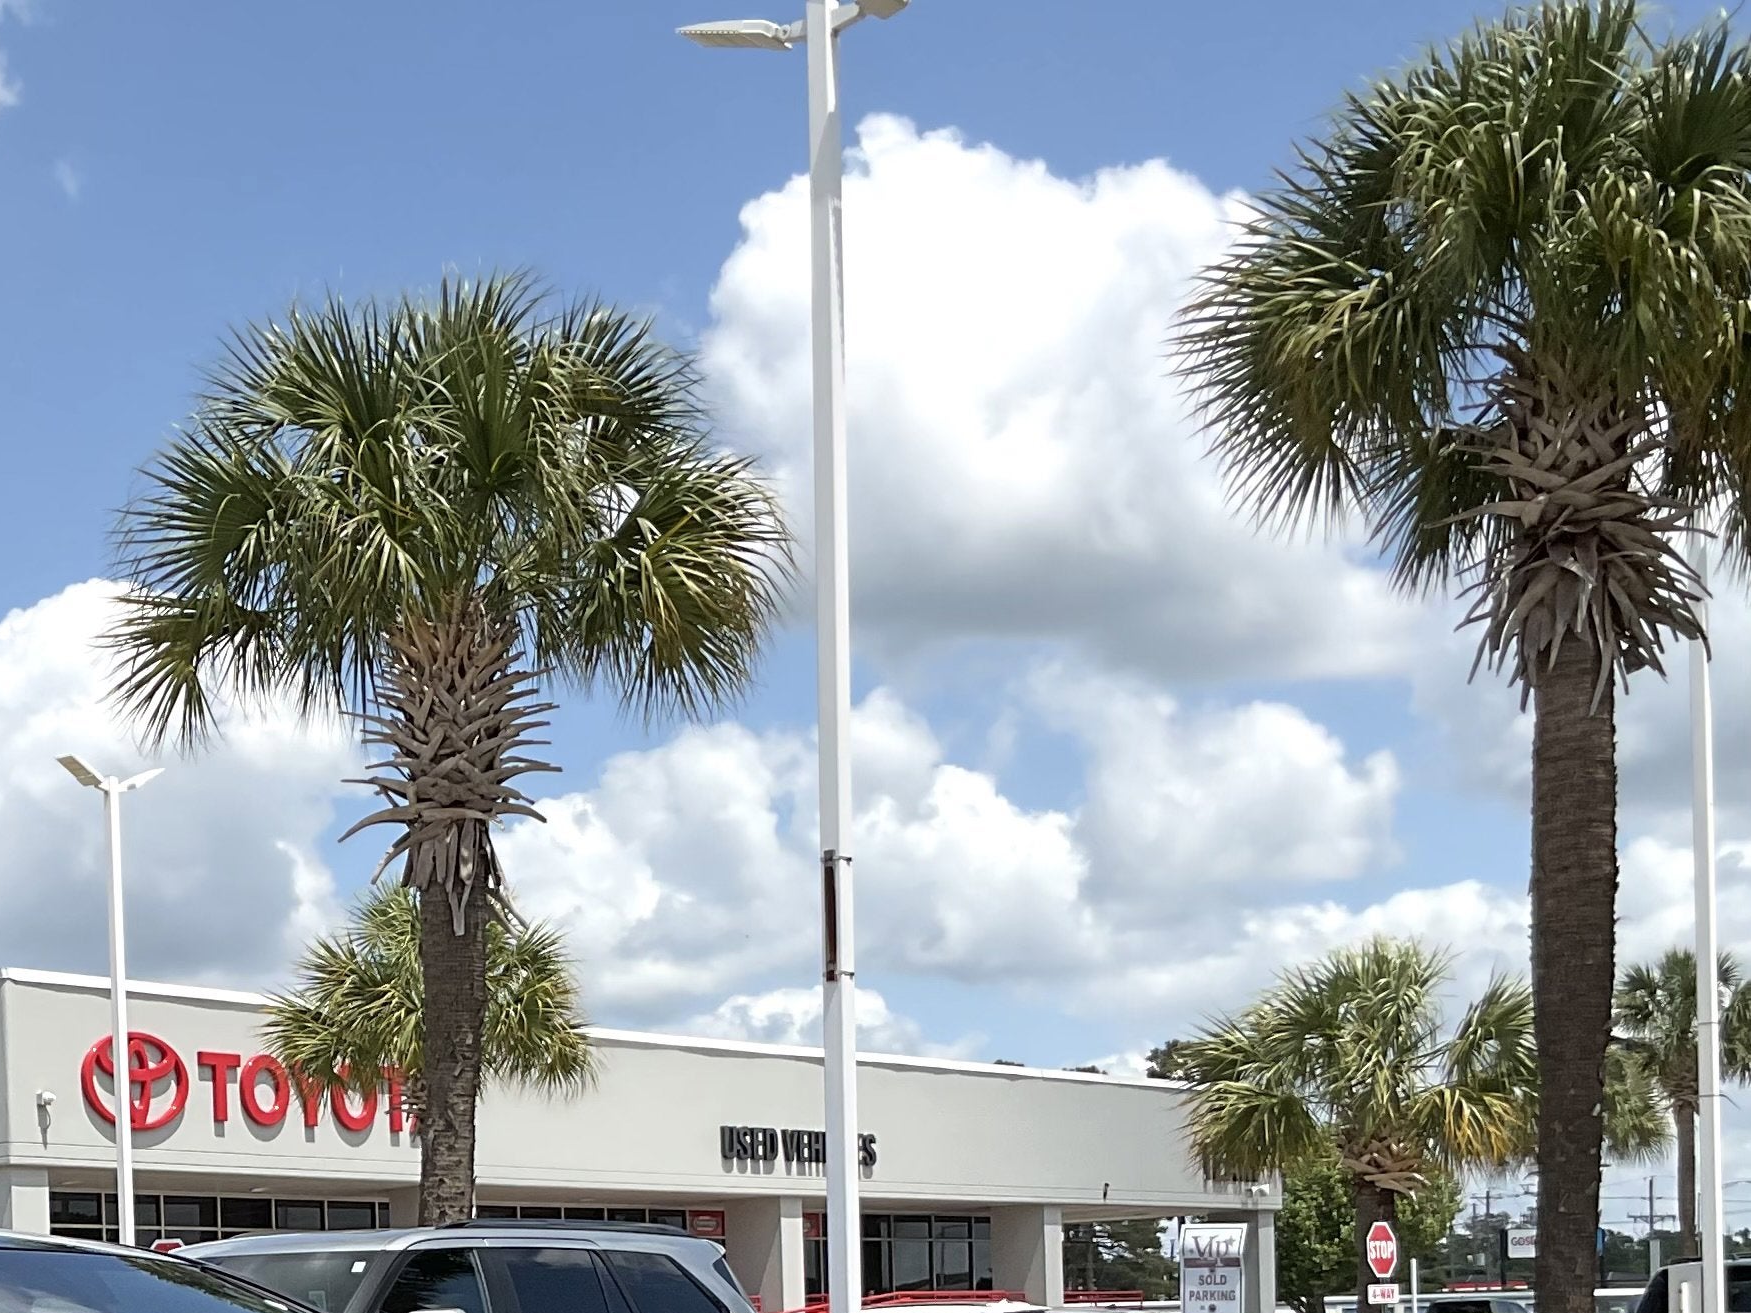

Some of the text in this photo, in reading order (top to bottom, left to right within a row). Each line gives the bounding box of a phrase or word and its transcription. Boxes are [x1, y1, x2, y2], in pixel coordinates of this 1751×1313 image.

[197, 1051, 420, 1133] TOYOT
[719, 1125, 779, 1161] USED
[1369, 1240, 1394, 1260] STOP
[1198, 1274, 1227, 1286] SOLD
[1189, 1289, 1236, 1302] PARKING
[1371, 1288, 1395, 1300] 4-WAY
